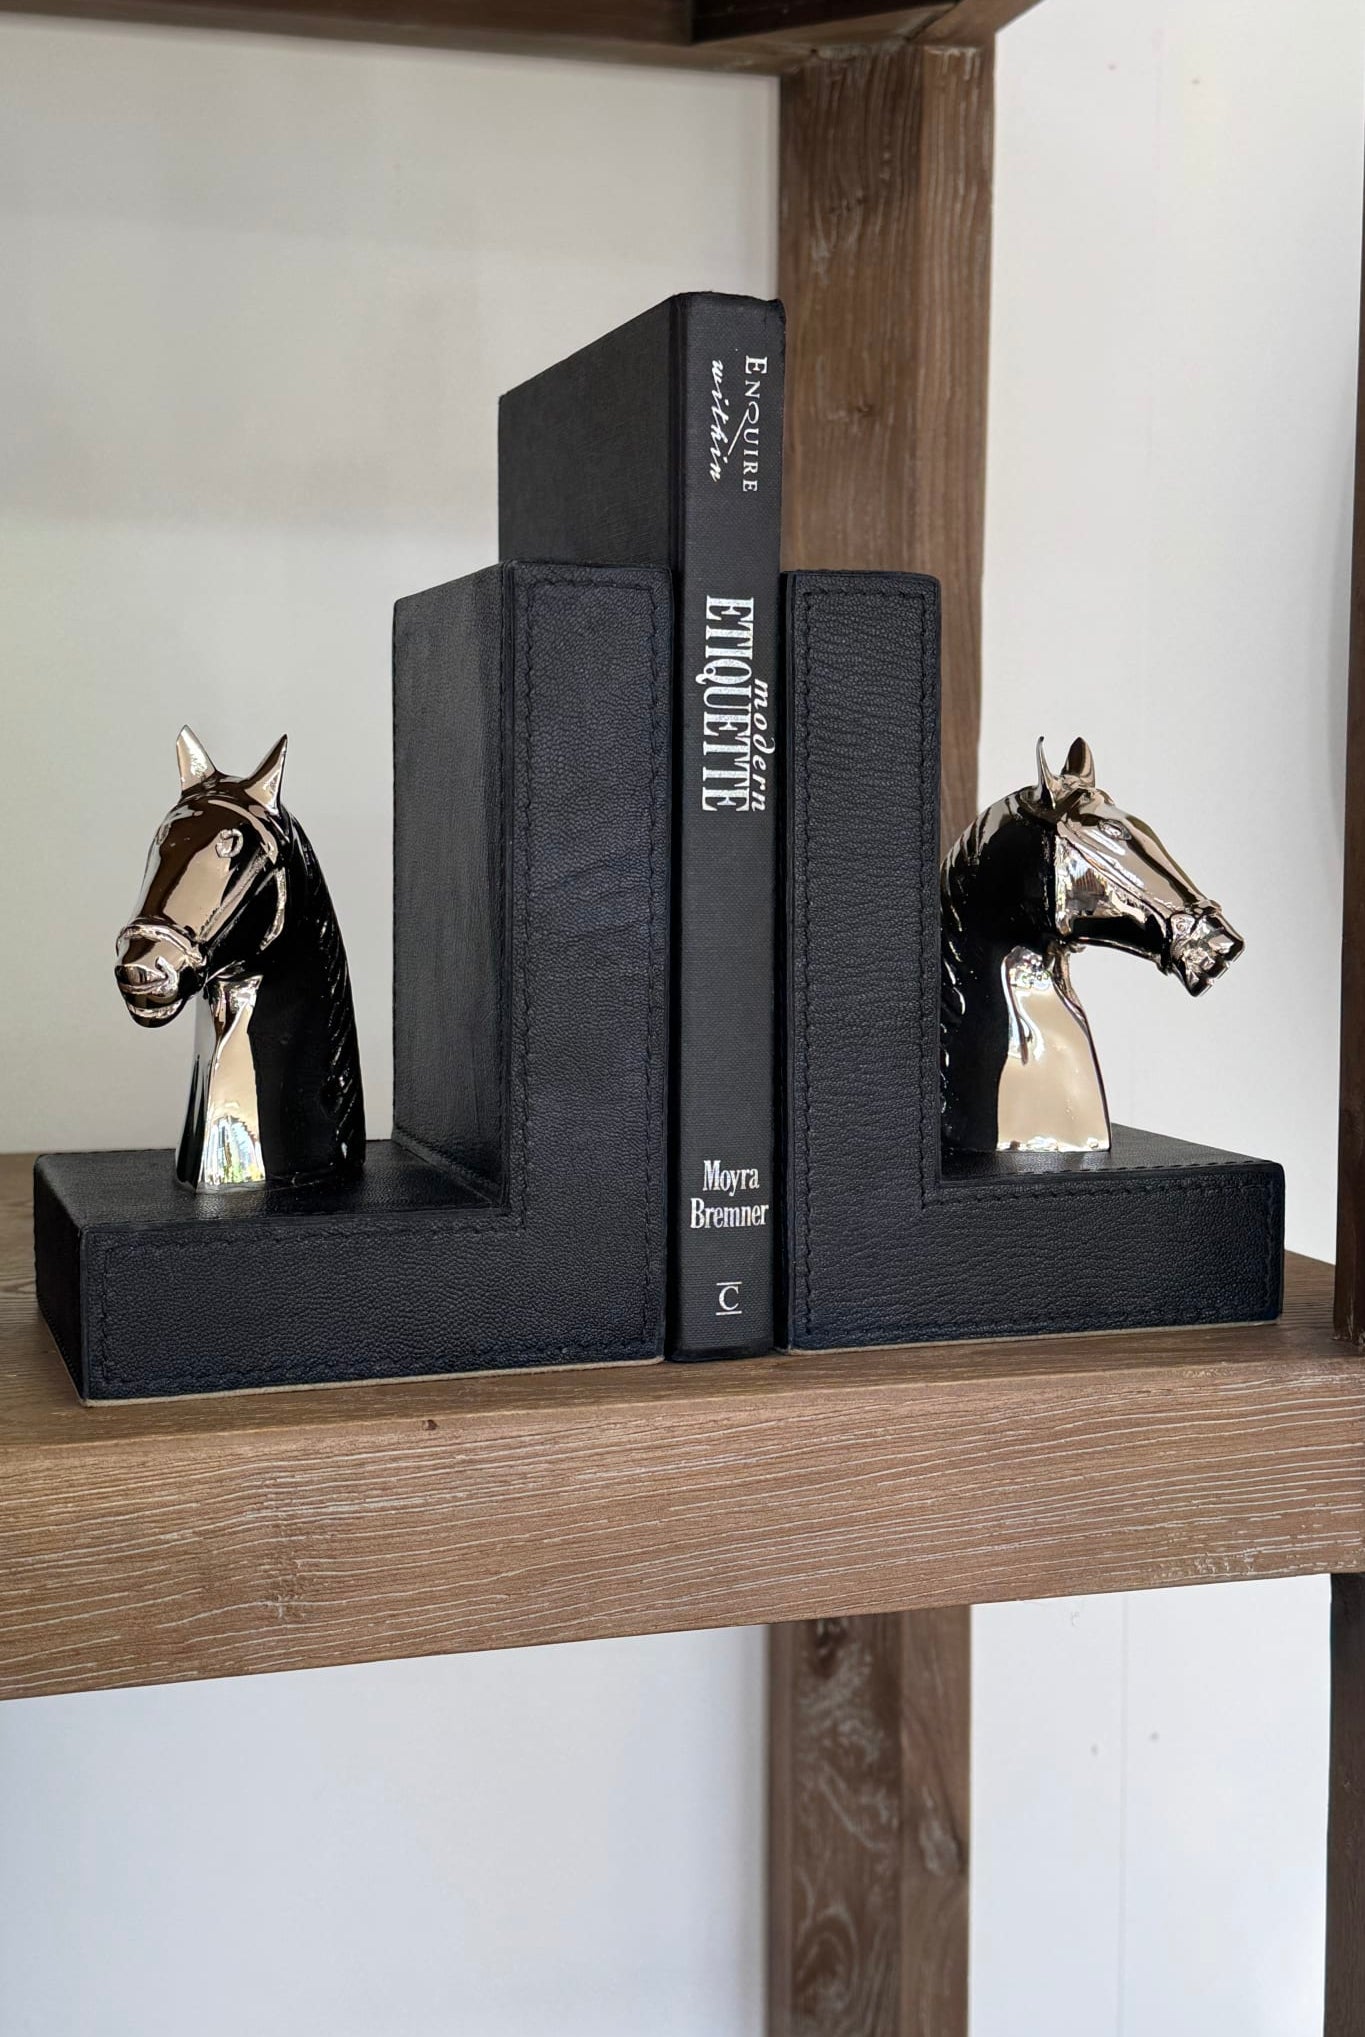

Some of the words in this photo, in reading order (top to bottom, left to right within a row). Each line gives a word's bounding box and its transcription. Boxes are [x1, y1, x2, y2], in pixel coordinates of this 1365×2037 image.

[709, 359, 729, 482] within
[728, 355, 768, 492] ENQUIRE
[695, 595, 754, 812] ETIQUETTE
[751, 678, 776, 812] modern
[690, 1197, 769, 1229] Bremner
[702, 1160, 760, 1197] Moyra
[718, 1285, 740, 1311] C
